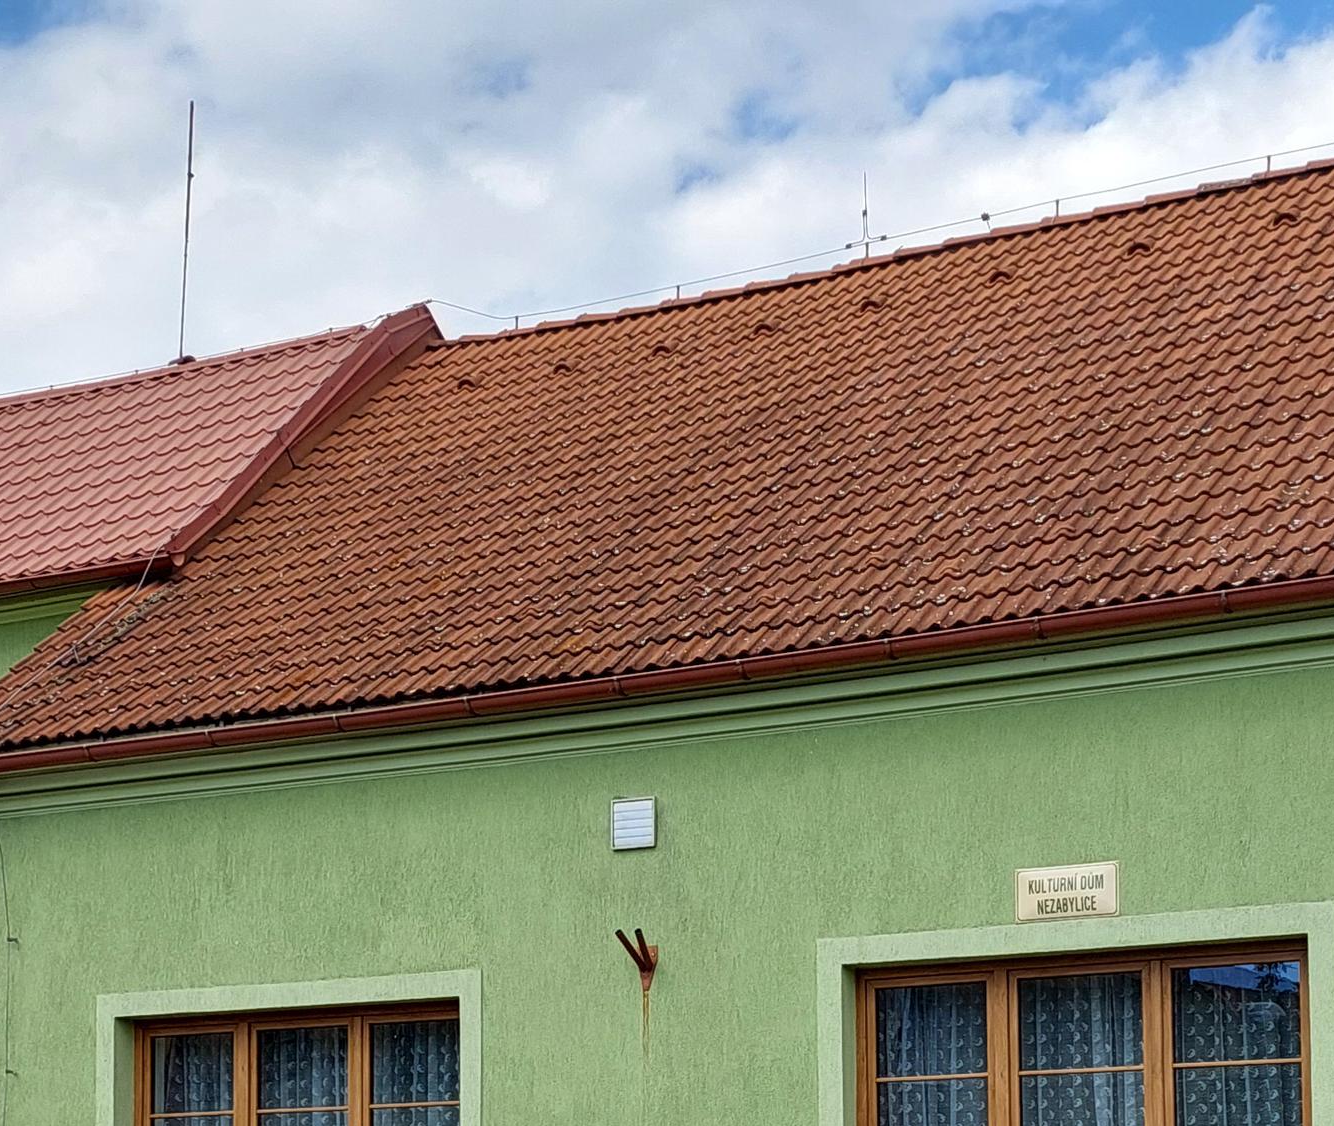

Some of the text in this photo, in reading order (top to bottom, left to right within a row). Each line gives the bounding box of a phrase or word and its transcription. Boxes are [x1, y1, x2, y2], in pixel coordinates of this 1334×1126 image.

[1028, 872, 1104, 895] KULTURNÍ DŮM
[1037, 895, 1097, 915] NEZABYLICE
